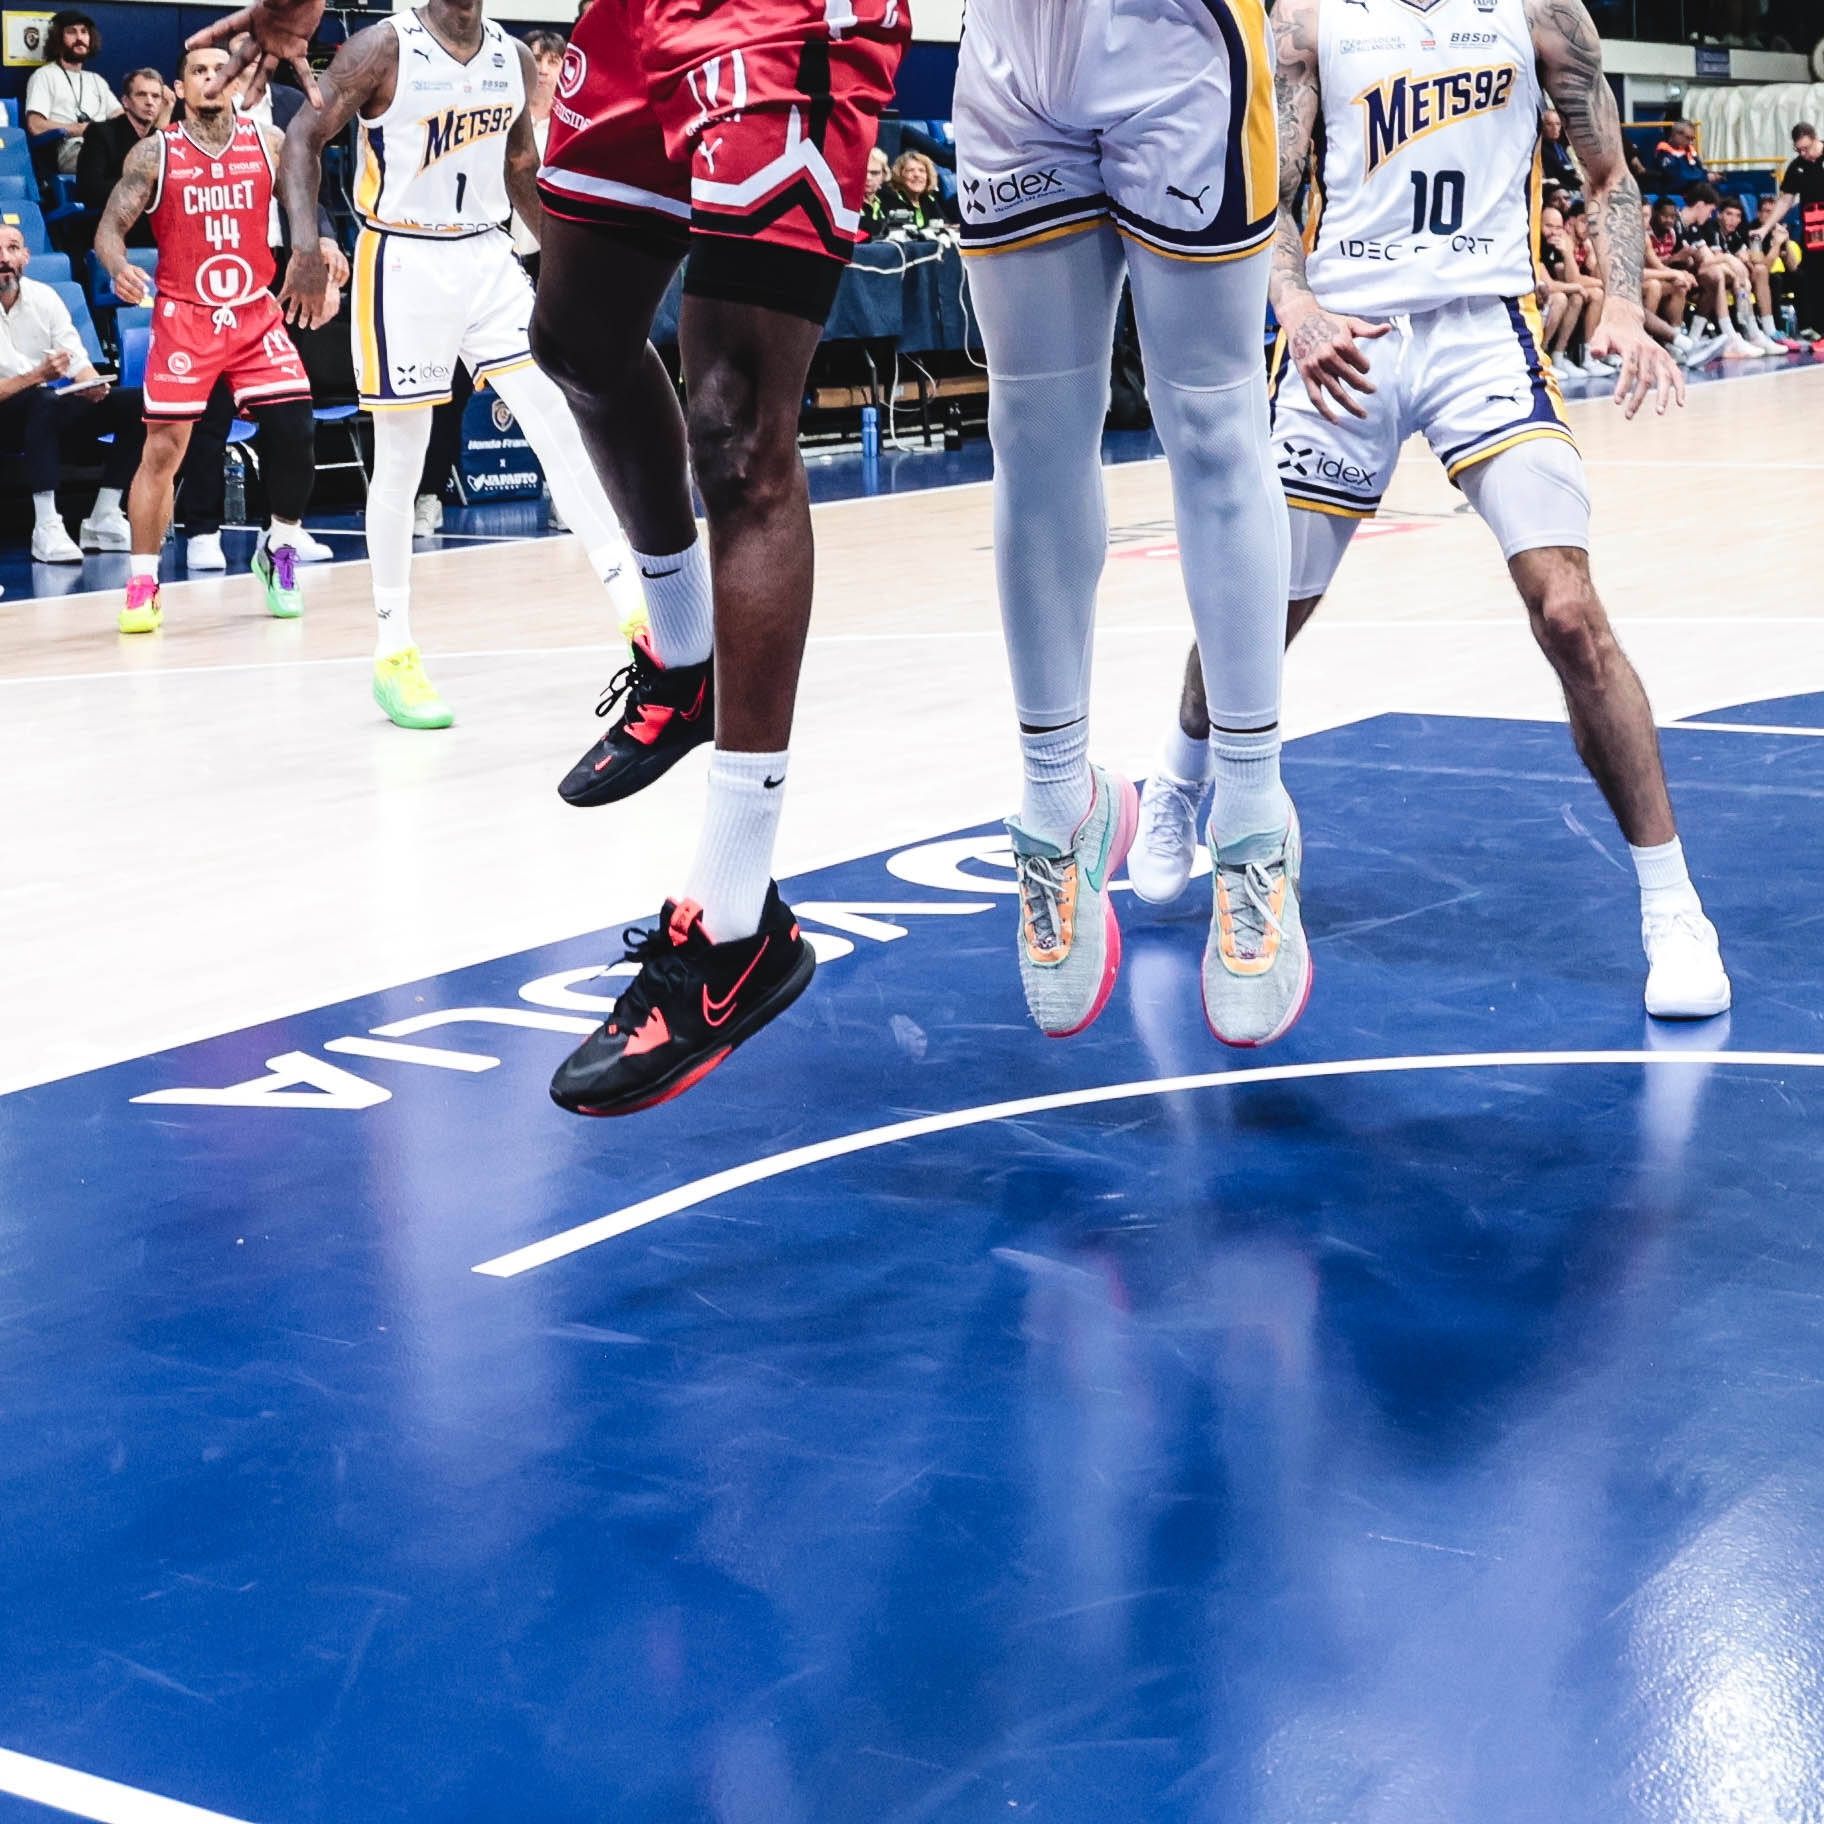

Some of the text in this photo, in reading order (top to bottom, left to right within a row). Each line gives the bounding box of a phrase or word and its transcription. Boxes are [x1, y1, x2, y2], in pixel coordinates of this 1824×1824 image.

[1363, 67, 1514, 174] METS92
[183, 179, 255, 215] CHOLET
[455, 172, 467, 214] 1
[987, 168, 1065, 205] idex
[1410, 170, 1466, 236] 10
[204, 214, 241, 251] 44
[1339, 239, 1404, 261] IDEC
[1316, 451, 1378, 488] idex
